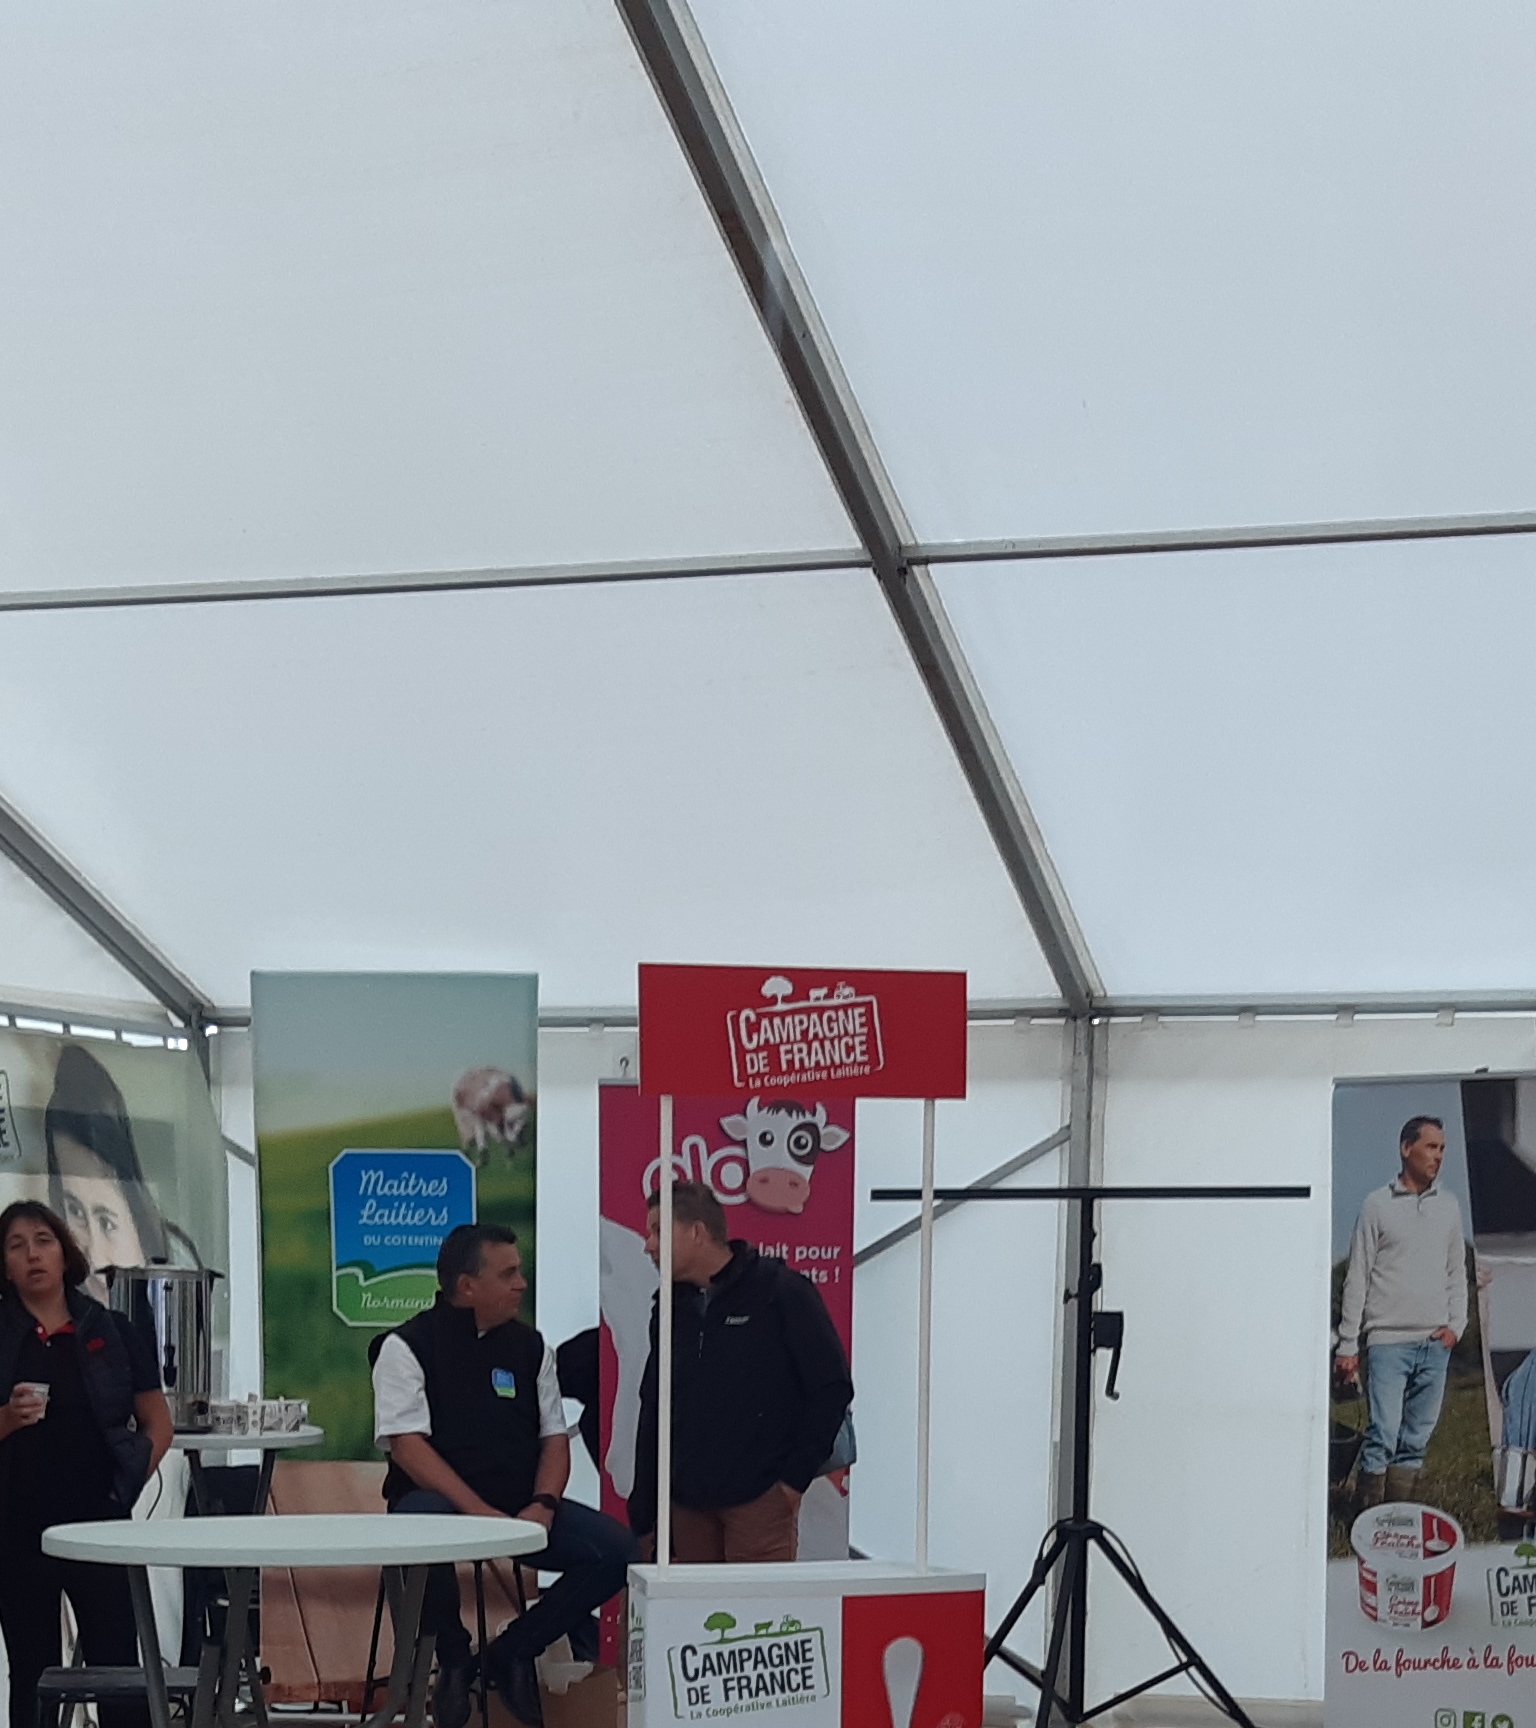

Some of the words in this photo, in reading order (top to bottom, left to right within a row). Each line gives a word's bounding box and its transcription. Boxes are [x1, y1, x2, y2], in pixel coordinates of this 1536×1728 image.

[739, 1007, 868, 1050] CAMPAGNE
[746, 1051, 770, 1075] DE
[779, 1035, 868, 1072] FRANCE
[749, 1076, 761, 1089] La
[764, 1068, 828, 1088] Coopérative
[359, 1169, 448, 1197] Maîtres
[359, 1199, 448, 1226] Laitiers
[364, 1235, 380, 1246] DU
[795, 1244, 842, 1262] pour
[361, 1292, 435, 1309] Normand
[1500, 1602, 1518, 1617] DE
[680, 1637, 814, 1682] CAMPAGNE
[1342, 1650, 1369, 1674] De
[1372, 1648, 1392, 1672] la
[1394, 1646, 1463, 1678] fourche
[1466, 1647, 1480, 1672] à
[1483, 1644, 1504, 1669] la
[687, 1685, 712, 1707] DE
[722, 1665, 815, 1702] FRANCE
[690, 1710, 702, 1720] La
[705, 1701, 774, 1718] Coopérative
